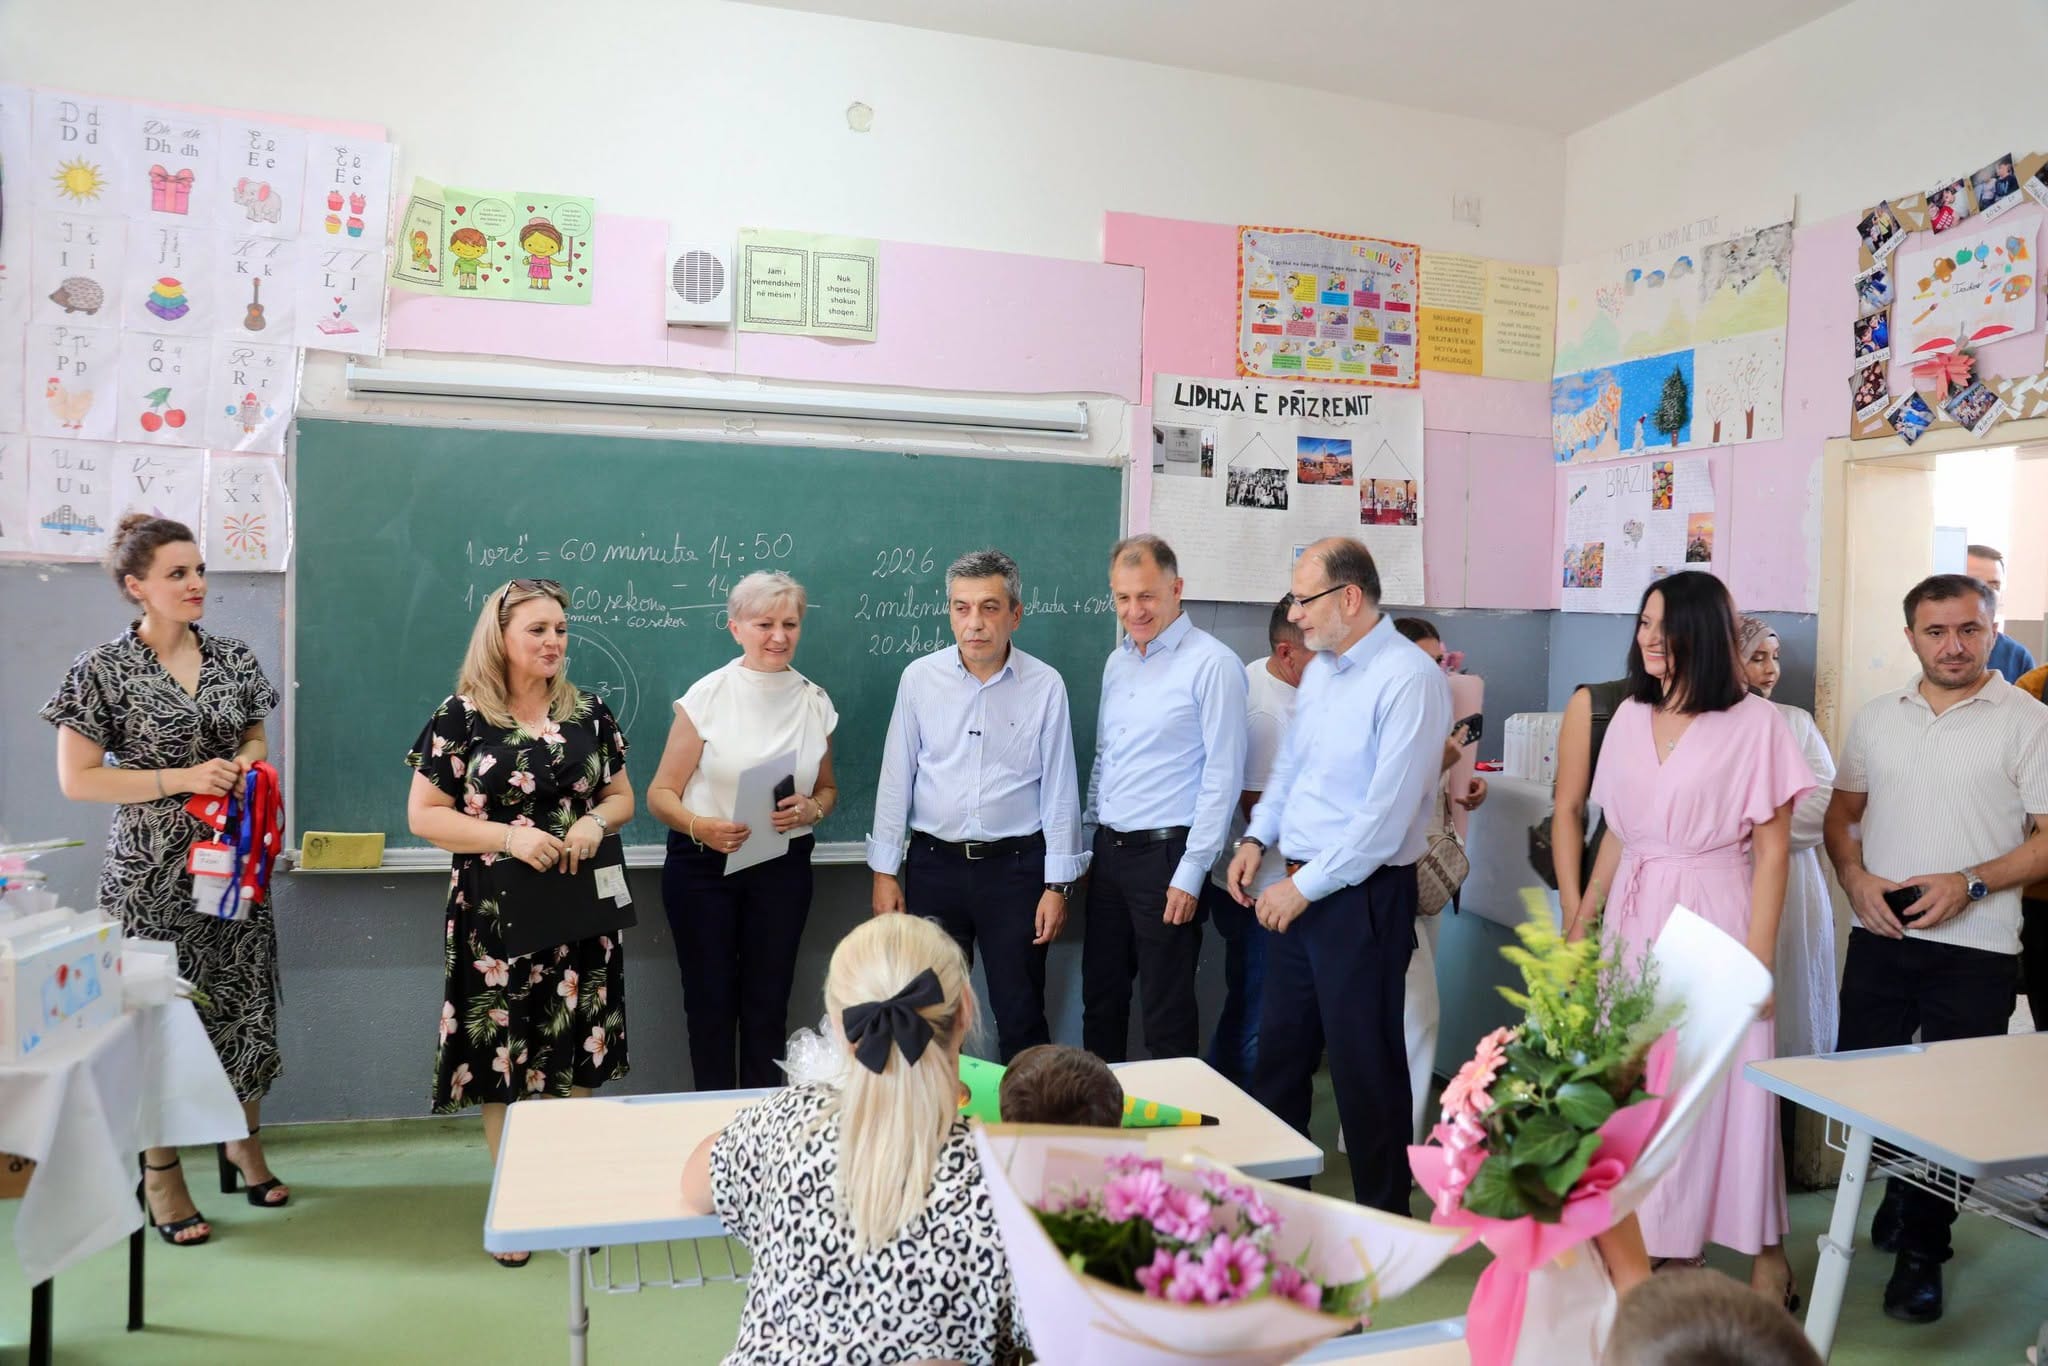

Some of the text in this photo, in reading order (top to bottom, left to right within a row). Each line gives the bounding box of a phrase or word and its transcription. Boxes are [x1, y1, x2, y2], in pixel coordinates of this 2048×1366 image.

[62, 126, 98, 145] D d
[145, 137, 199, 157] Dh dh
[248, 152, 275, 168] E e
[236, 261, 272, 276] K k
[767, 267, 782, 275] Jam
[324, 274, 336, 288] L
[836, 274, 851, 283] Nuk
[56, 356, 87, 376] P p
[149, 357, 181, 376] Q q
[233, 371, 269, 388] R r
[1174, 383, 1245, 412] LIDHJA
[1278, 389, 1373, 418] PRIZRENIT
[56, 478, 91, 495] U u
[135, 476, 175, 495] V v
[1606, 464, 1653, 498] BRAZIL
[224, 488, 261, 503] X x
[465, 541, 473, 563] 1
[560, 538, 596, 562] 60
[872, 547, 934, 577] 2026
[572, 586, 600, 609] 60
[854, 593, 871, 620] 2
[869, 625, 956, 655] 20 shek
